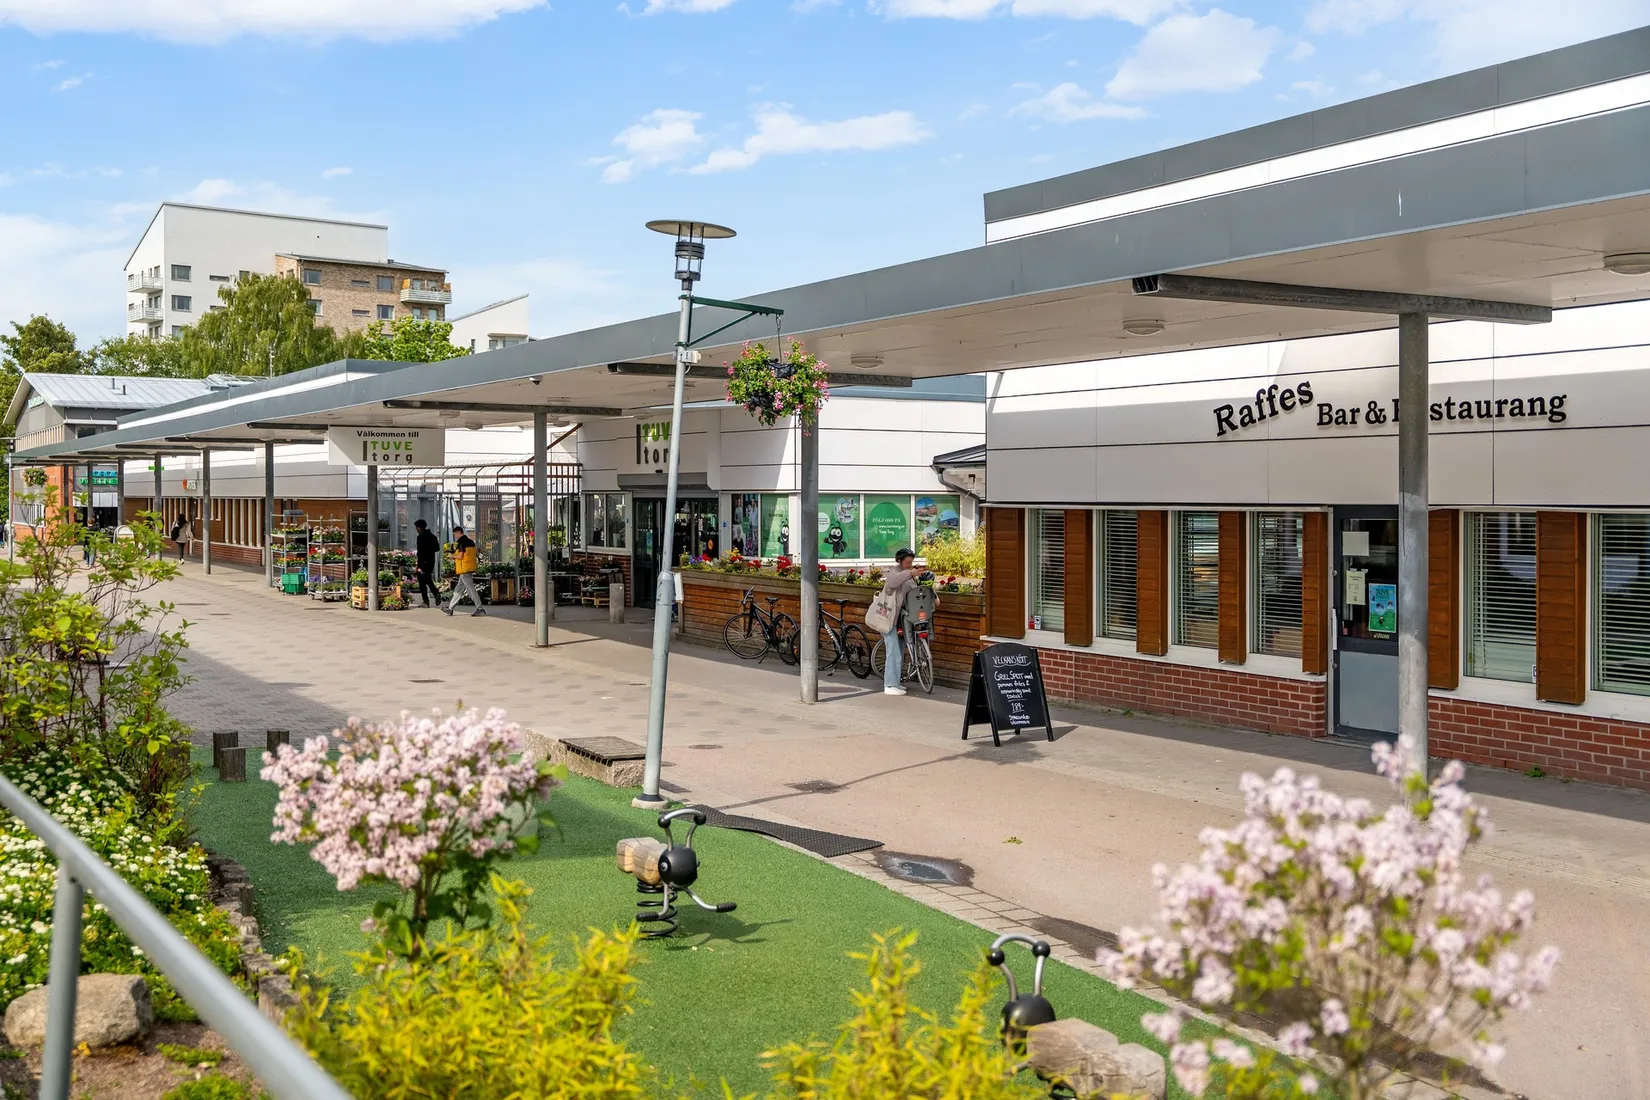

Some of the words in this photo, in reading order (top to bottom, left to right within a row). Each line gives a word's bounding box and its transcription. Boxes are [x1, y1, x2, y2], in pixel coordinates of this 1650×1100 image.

[1213, 379, 1314, 437] Raffes
[1317, 403, 1360, 427] Bar
[1365, 400, 1387, 424] &
[1392, 392, 1568, 423] staurang
[356, 430, 406, 438] Välkommen
[642, 421, 671, 442] TUV
[370, 440, 413, 451] TUVE
[372, 452, 413, 464] torg
[644, 446, 676, 464] tor
